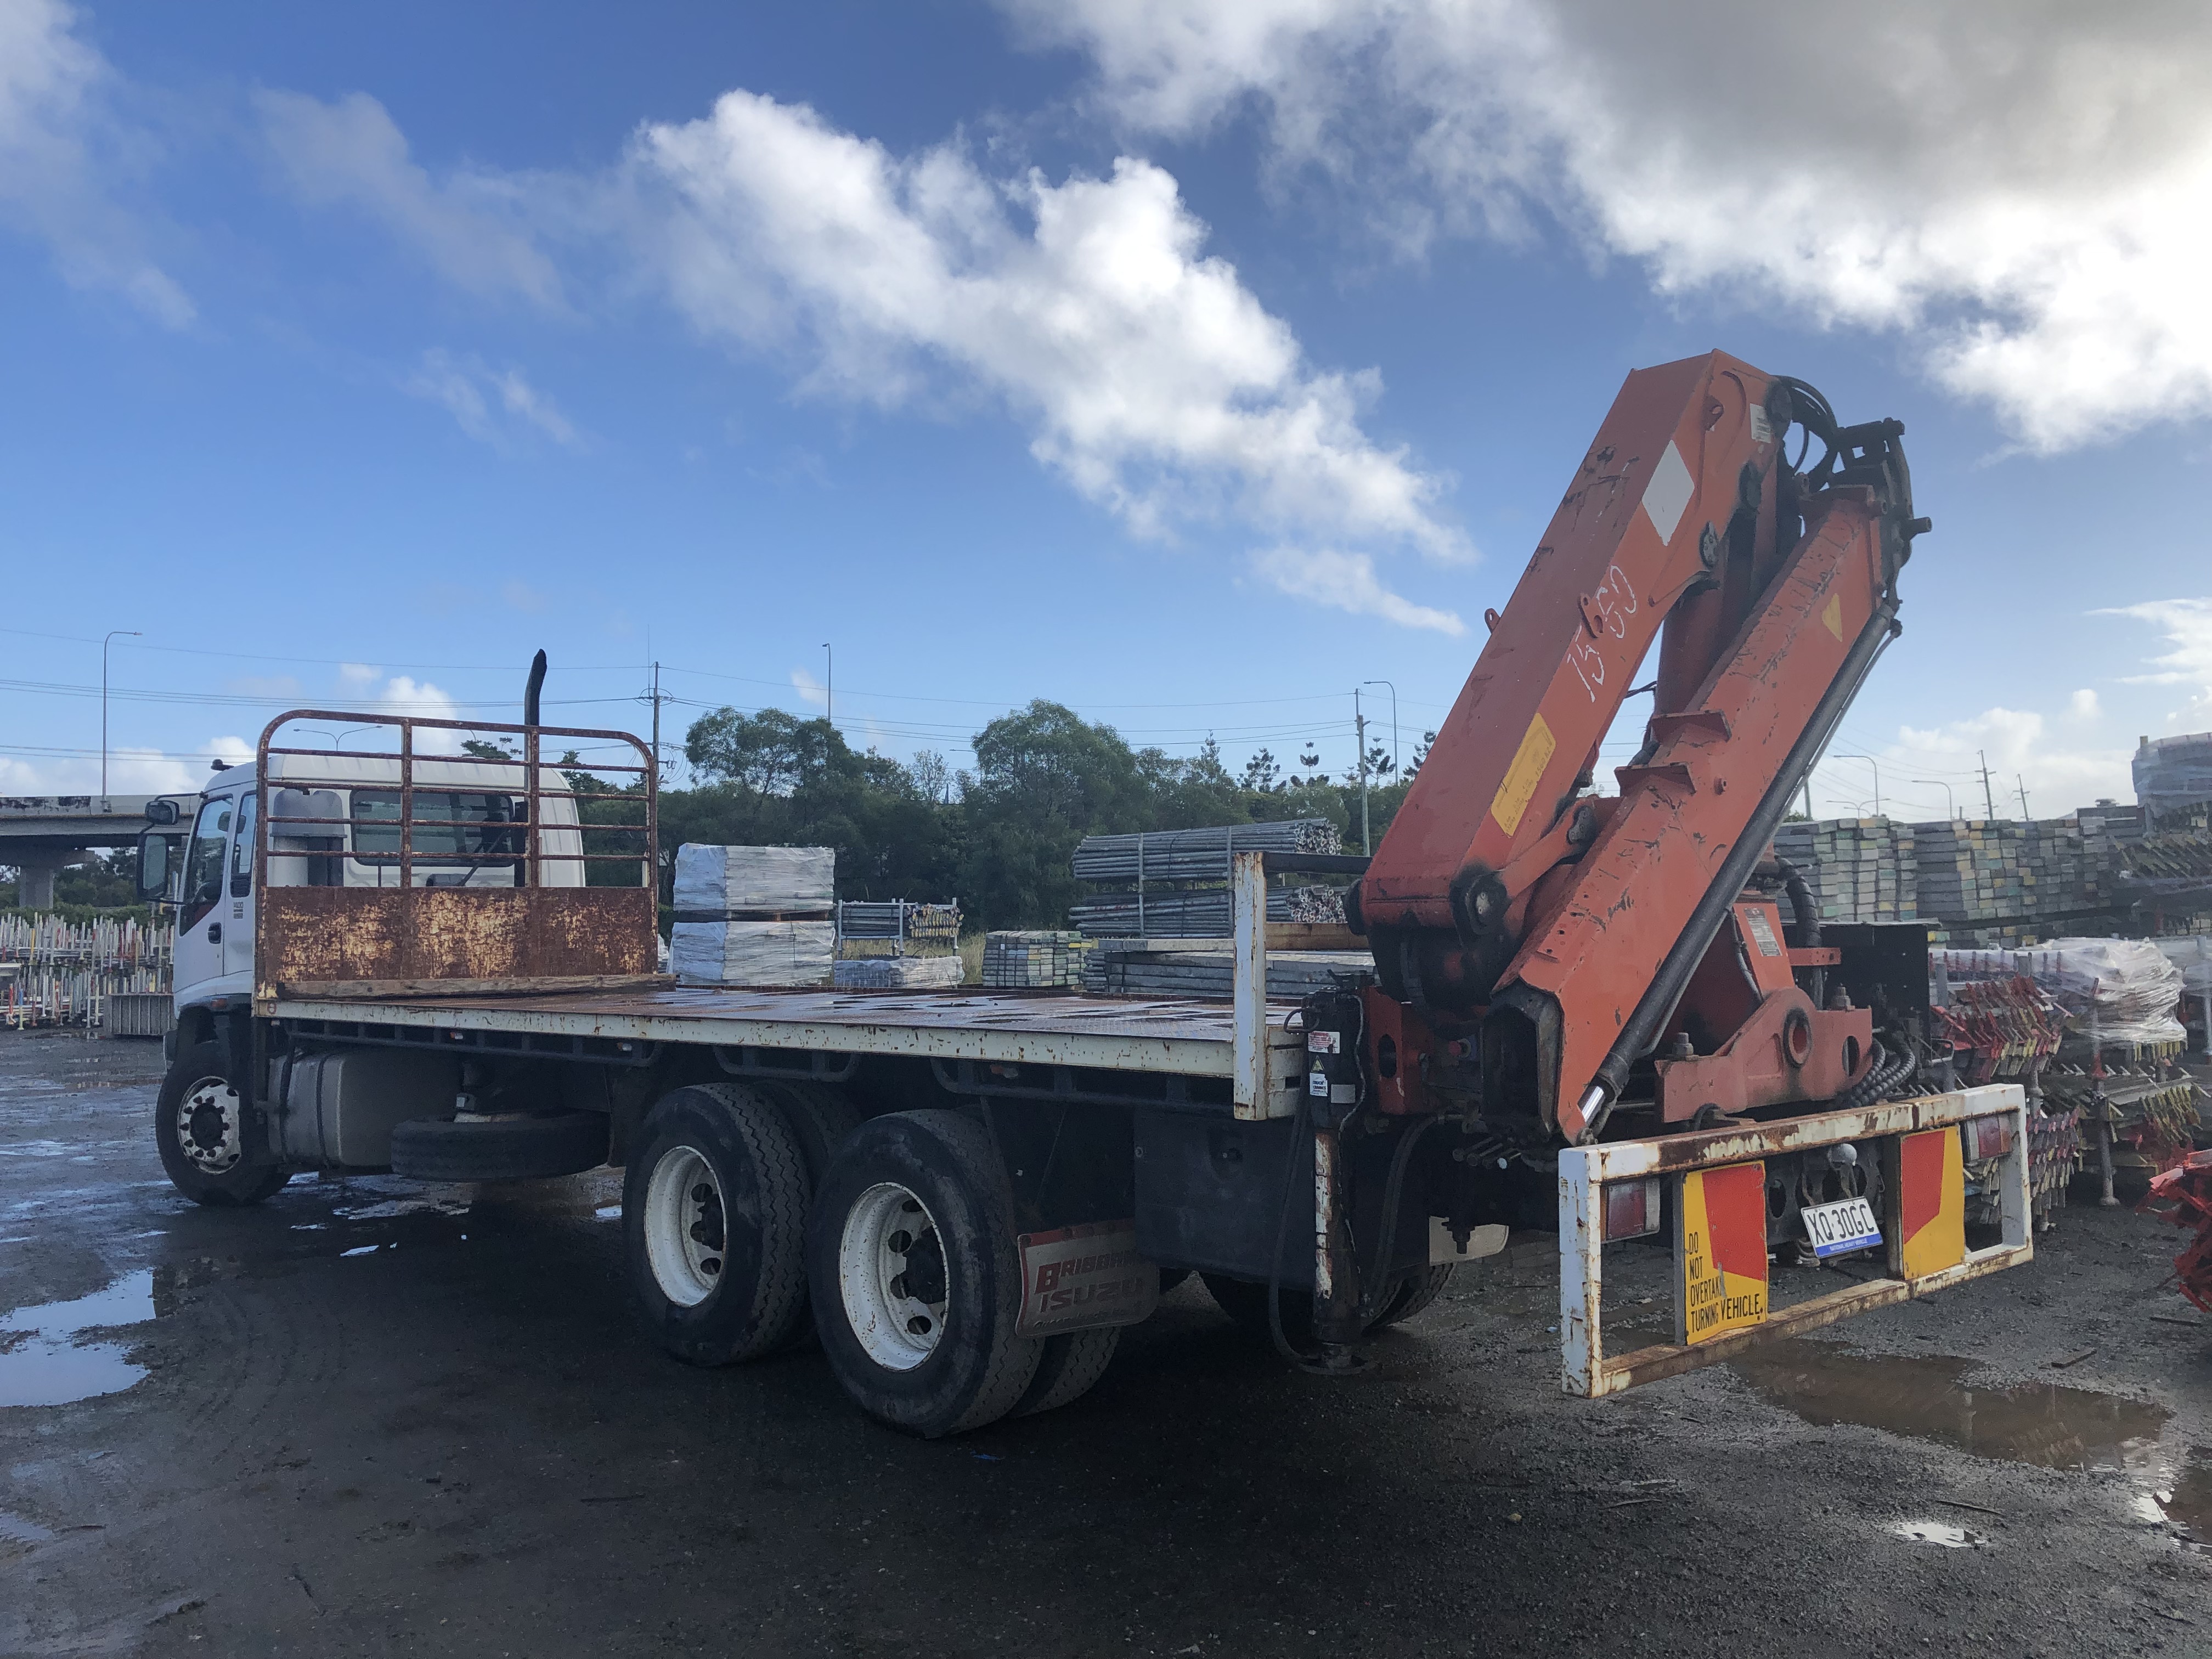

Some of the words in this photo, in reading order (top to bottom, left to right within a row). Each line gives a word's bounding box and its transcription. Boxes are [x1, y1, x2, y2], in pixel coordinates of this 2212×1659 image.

[1689, 1232, 1699, 1255] DO
[1690, 1256, 1703, 1281] NOT
[1040, 1277, 1144, 1313] ISUZU
[1690, 1276, 1723, 1307] OVERTAK
[1691, 1302, 1718, 1333] TURNING
[1720, 1293, 1760, 1320] VEHICLE
